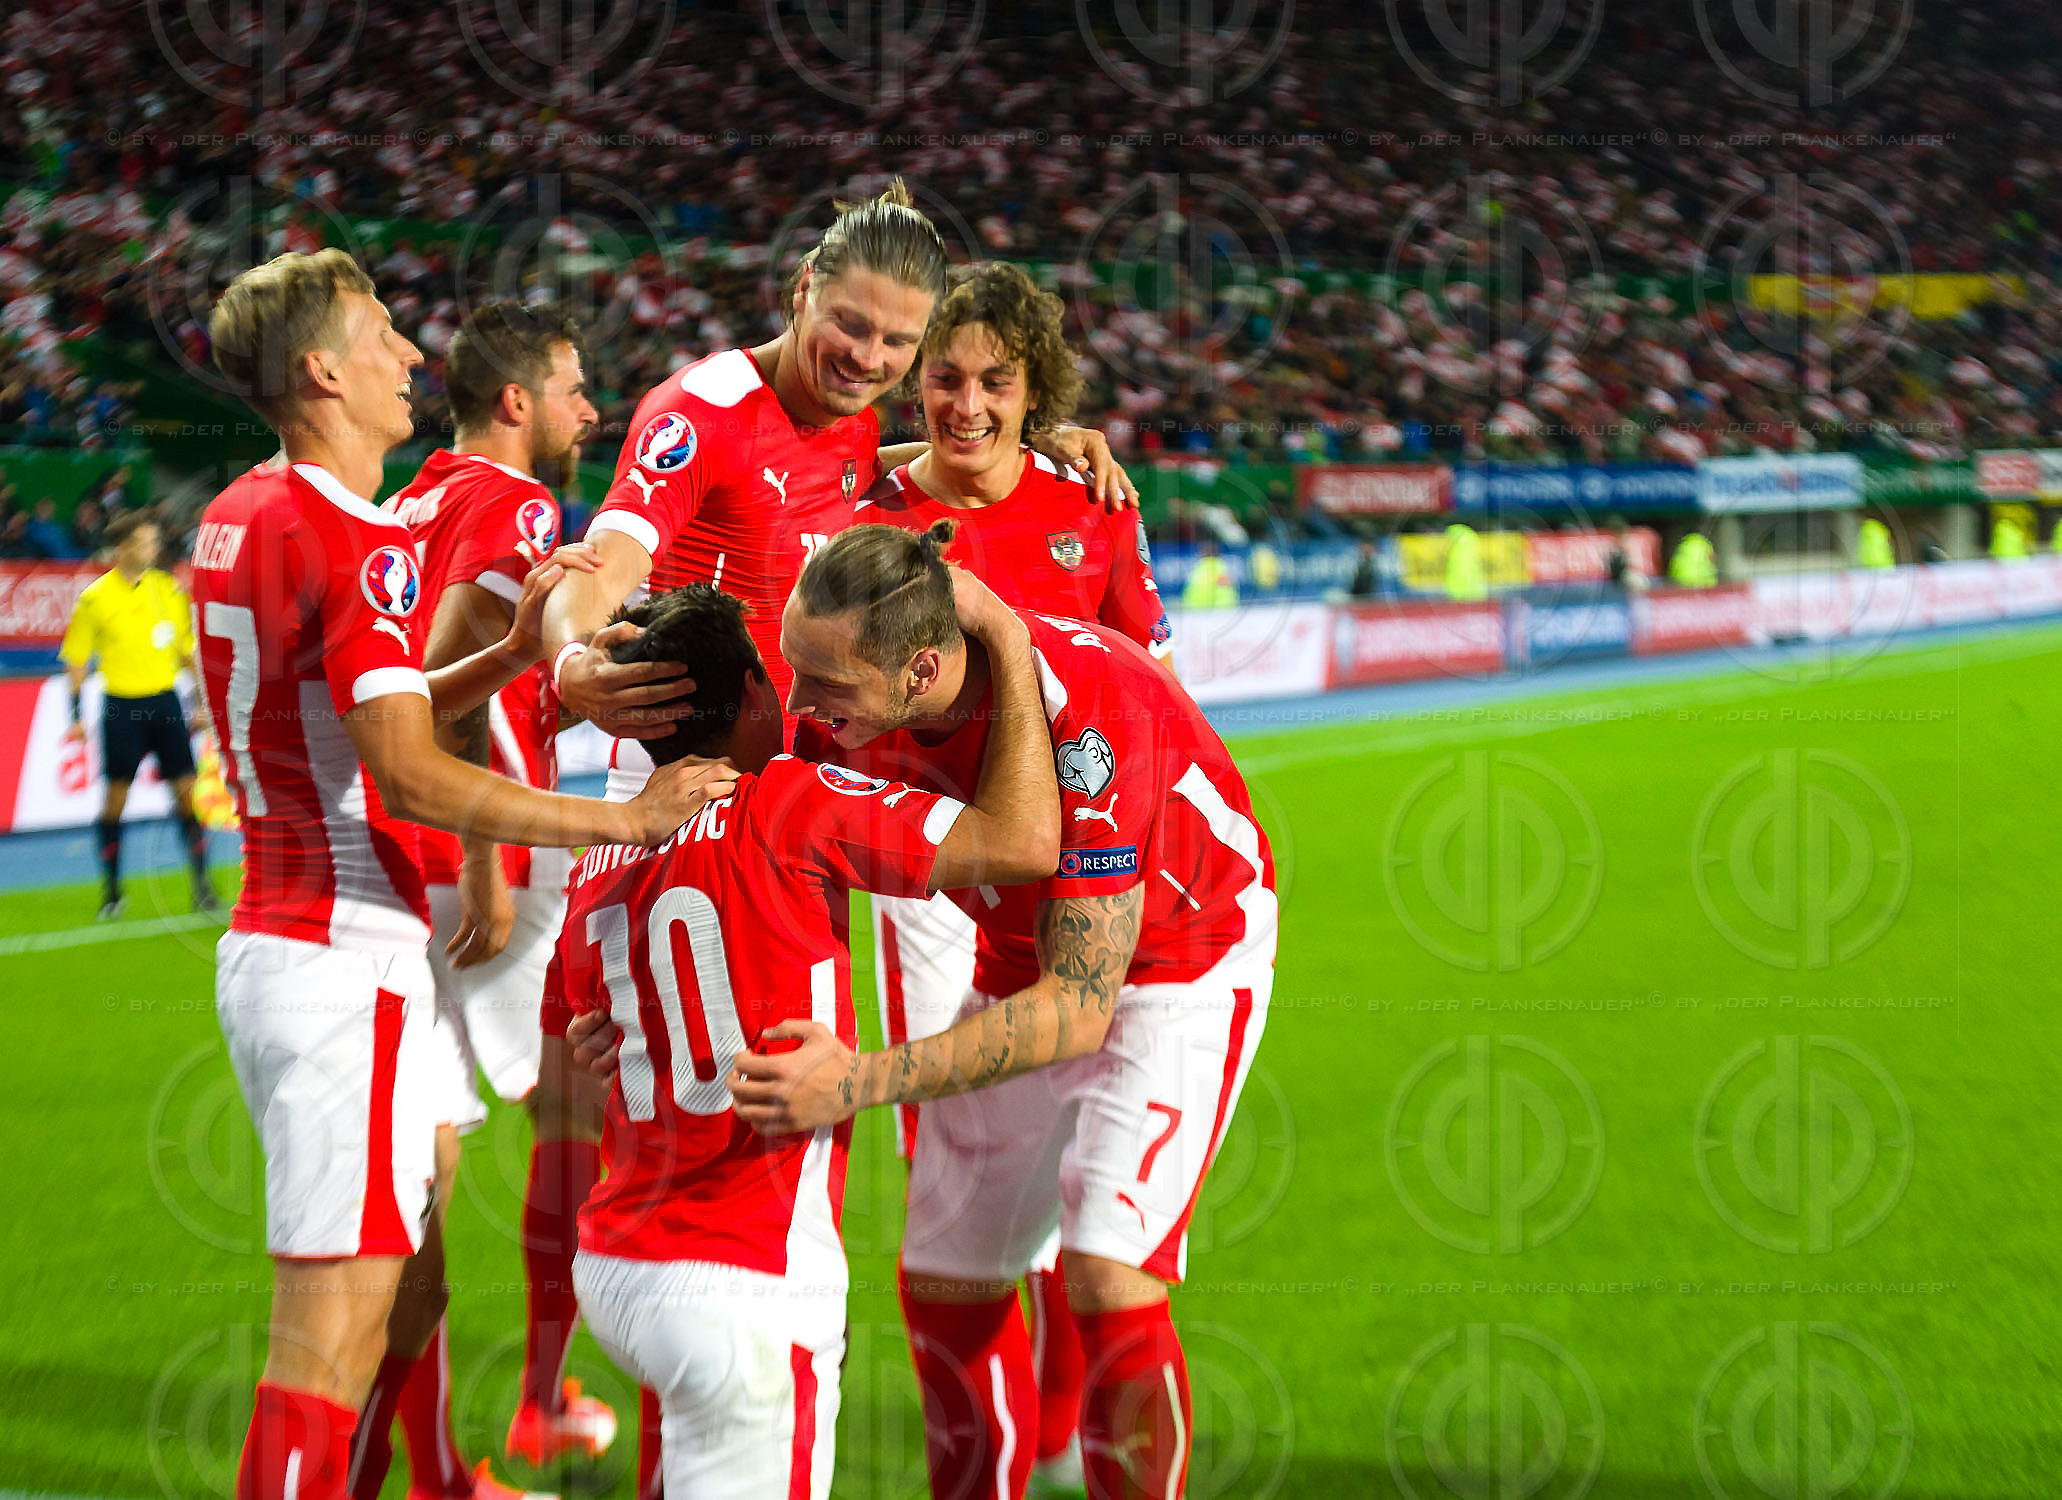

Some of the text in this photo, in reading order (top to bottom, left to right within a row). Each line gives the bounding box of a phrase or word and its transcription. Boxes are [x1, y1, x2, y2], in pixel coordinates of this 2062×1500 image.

[1083, 853, 1137, 870] RESPECT
[586, 886, 747, 1122] 10
[1136, 1101, 1183, 1184] 7
